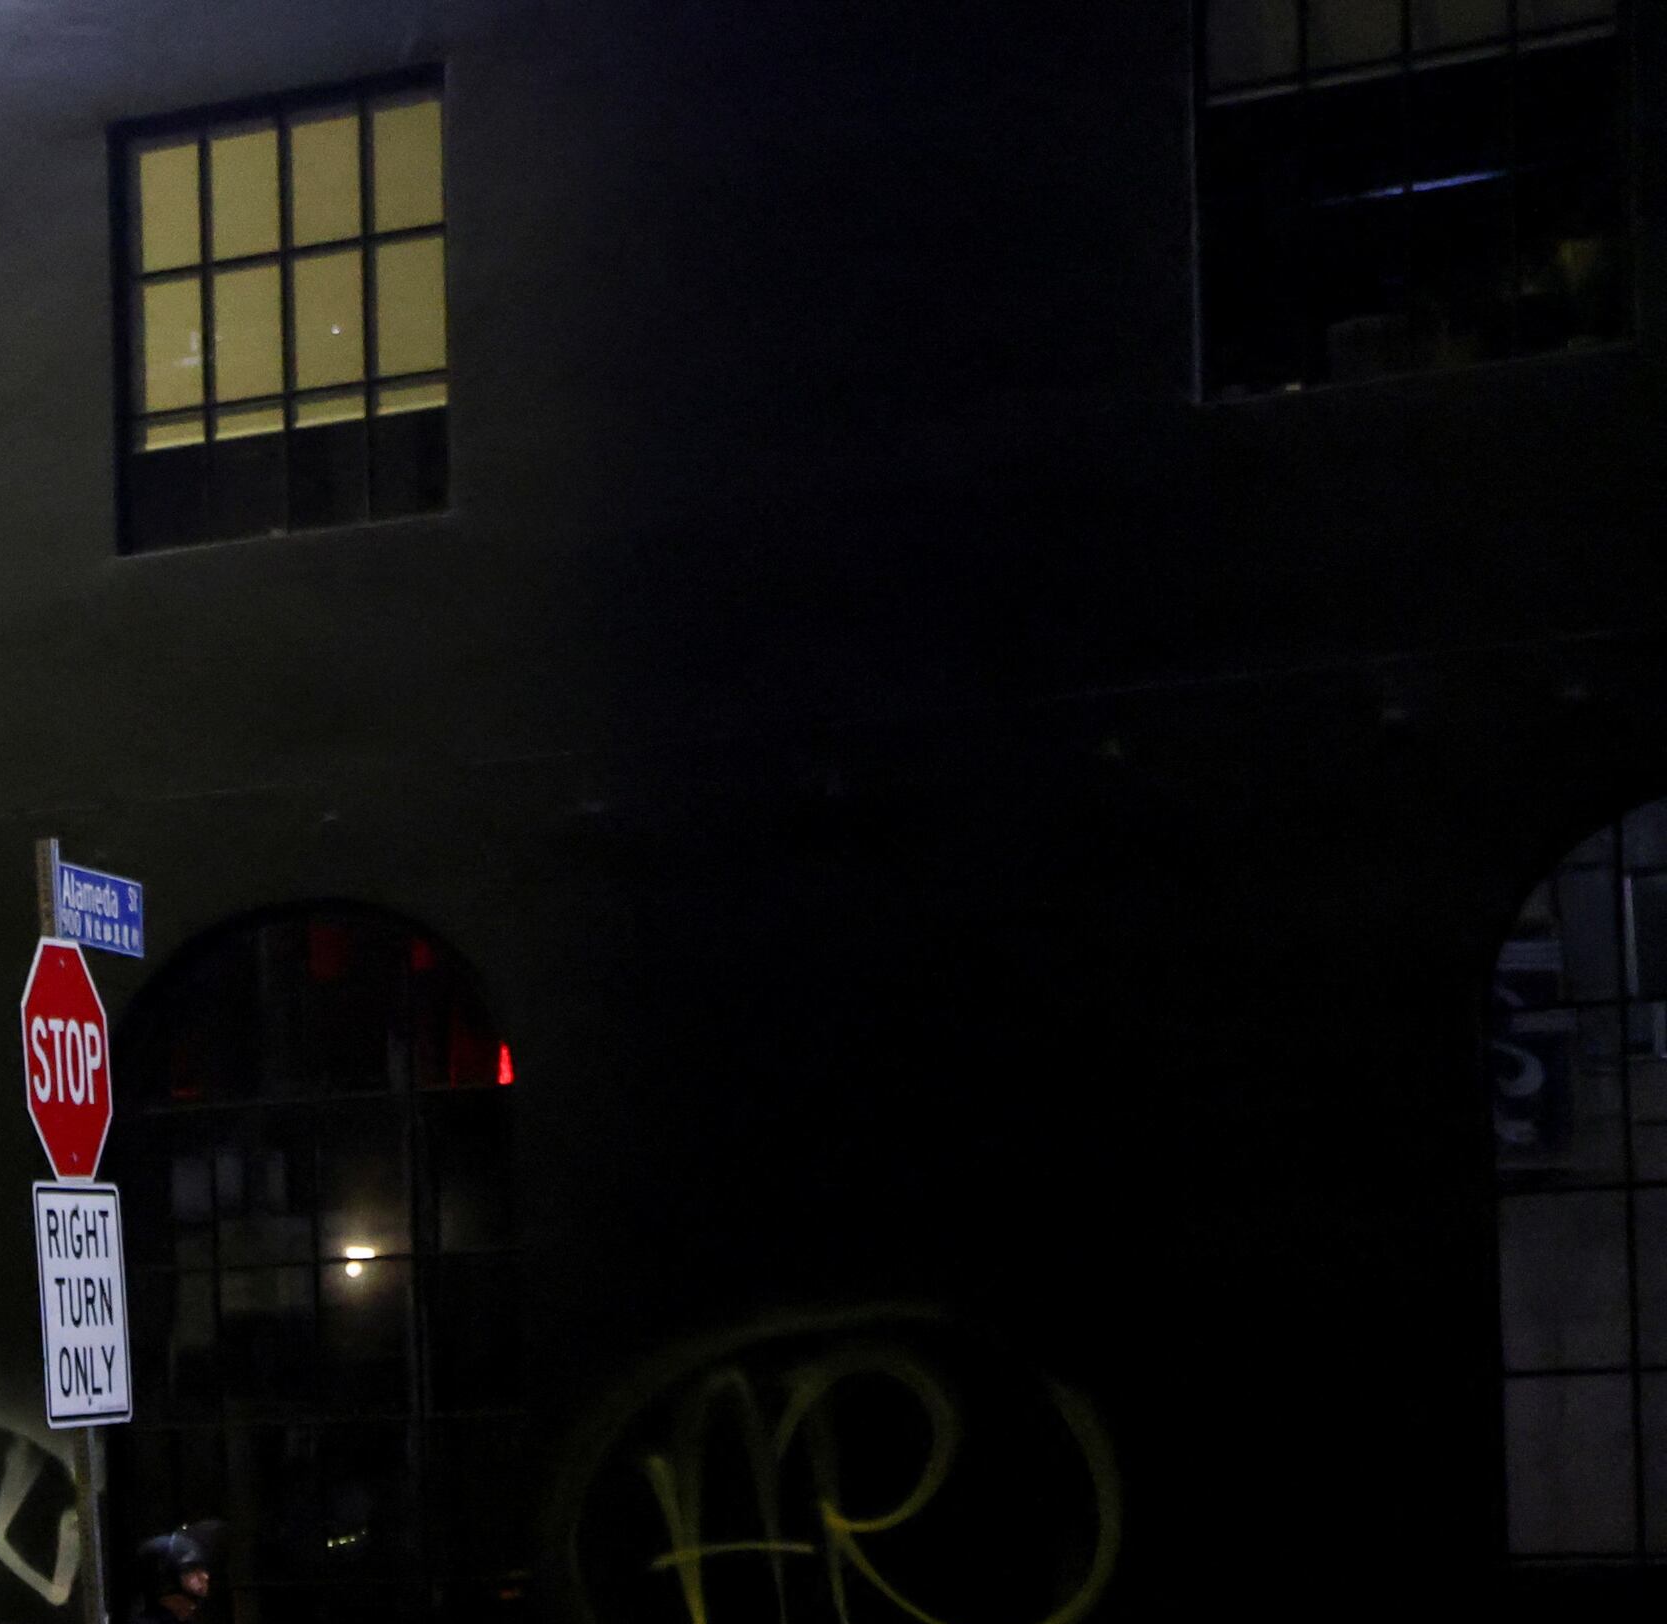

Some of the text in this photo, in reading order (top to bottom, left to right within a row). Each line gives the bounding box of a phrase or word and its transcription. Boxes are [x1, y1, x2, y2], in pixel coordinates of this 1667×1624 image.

[62, 868, 119, 920] Alameda
[30, 1016, 103, 1106] STOP
[46, 1207, 110, 1259] RIGHT
[54, 1276, 114, 1328] TURN
[58, 1344, 116, 1398] ONLY
